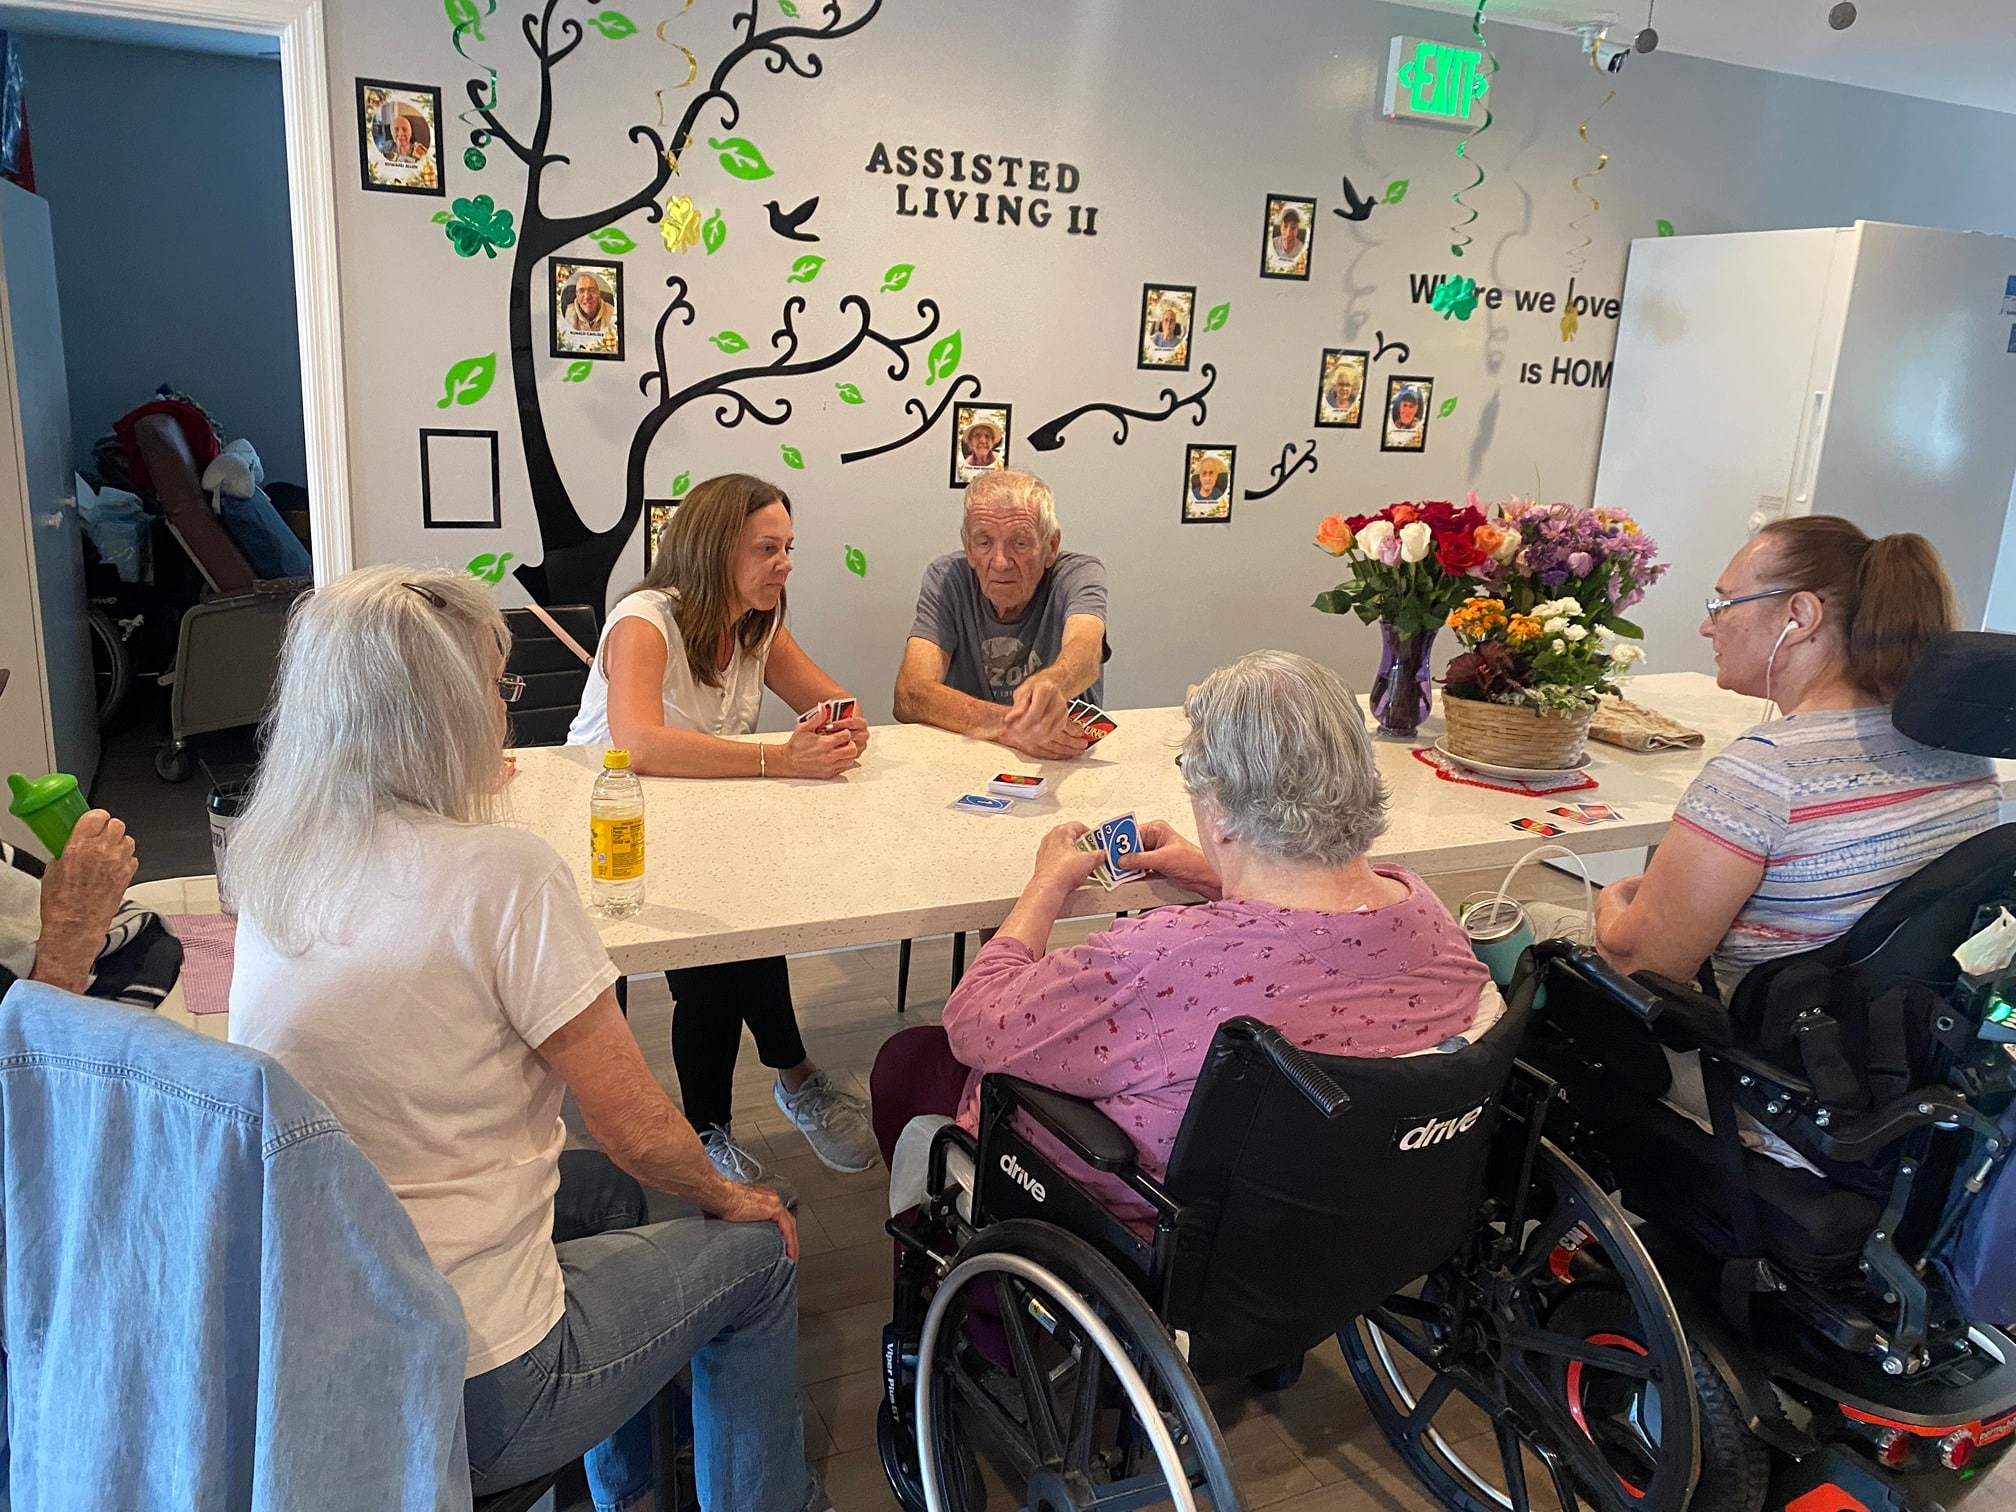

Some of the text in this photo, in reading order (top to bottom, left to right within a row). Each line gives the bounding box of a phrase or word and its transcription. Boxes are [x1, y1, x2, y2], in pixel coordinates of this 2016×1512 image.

[1410, 42, 1481, 119] EXIT
[865, 141, 1080, 193] ASSISTED
[896, 183, 1098, 236] LIVING II
[1515, 289, 1556, 313] we
[1565, 277, 1620, 319] love
[1105, 825, 1113, 834] 3
[1115, 833, 1131, 855] 3
[1399, 1105, 1483, 1151] drive
[1000, 1154, 1046, 1202] drive
[885, 1343, 894, 1376] Viper
